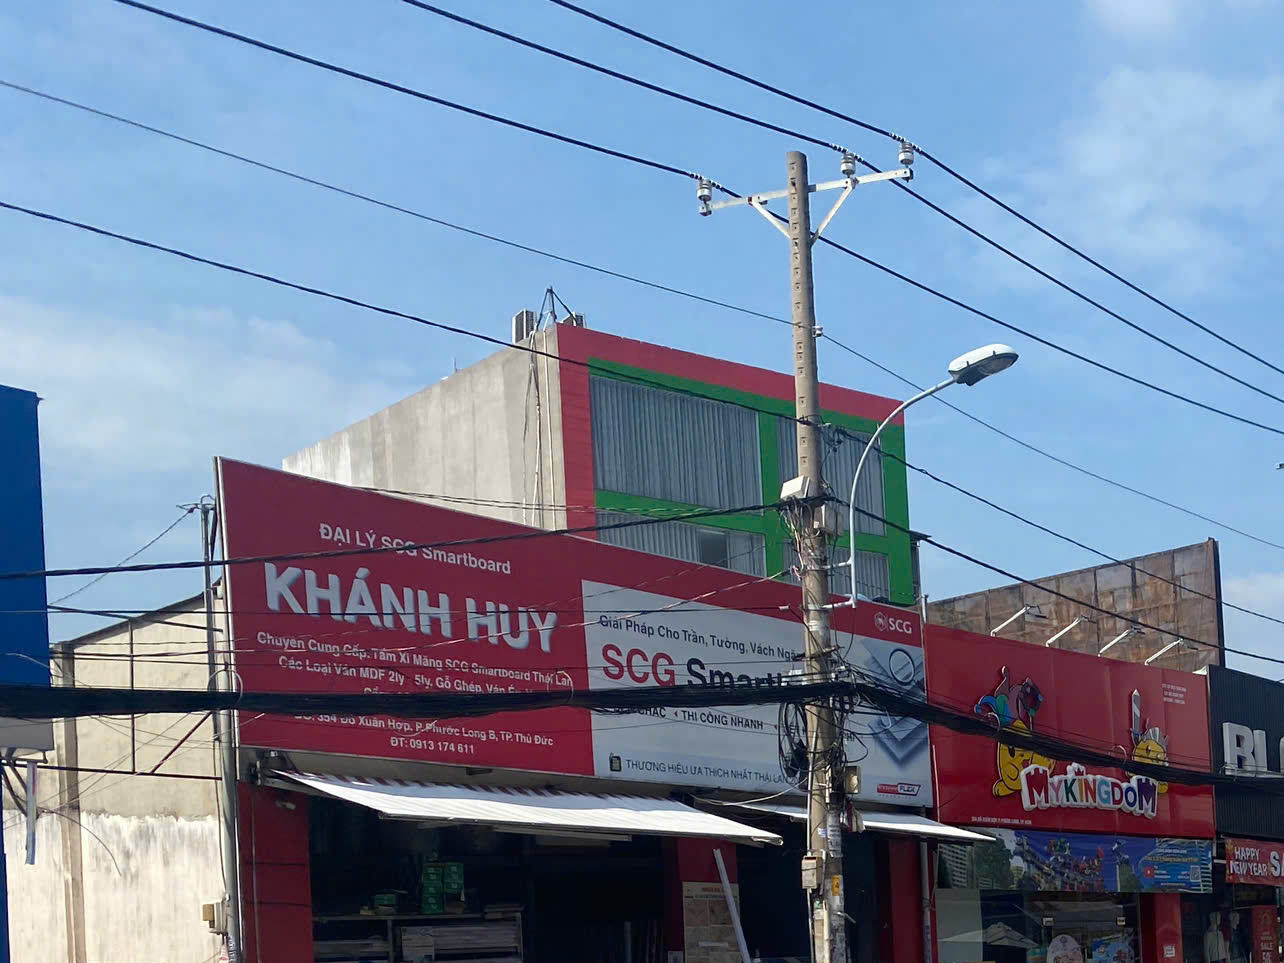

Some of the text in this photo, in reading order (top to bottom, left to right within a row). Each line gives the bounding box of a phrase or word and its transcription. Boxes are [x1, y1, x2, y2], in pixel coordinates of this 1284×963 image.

[319, 523, 350, 546] ĐẠI
[356, 529, 377, 549] LÝ
[422, 547, 511, 574] Smartboard
[264, 562, 557, 653] KHÁNH HUY
[889, 616, 912, 635] SCG
[626, 619, 654, 636] Pháp
[657, 625, 680, 640] Cho
[750, 642, 775, 658] Vách
[257, 631, 305, 650] Chuyên
[308, 639, 339, 656] Cung
[413, 654, 442, 671] Măng
[360, 667, 386, 681] MDF
[601, 644, 676, 687] SCG
[682, 710, 698, 721] THI
[700, 711, 728, 726] CÔNG
[731, 718, 764, 730] NHANH
[462, 727, 486, 741] Long
[409, 739, 435, 750] 0913
[1234, 847, 1260, 861] HAPPY
[1230, 861, 1268, 876] NEW YEAR
